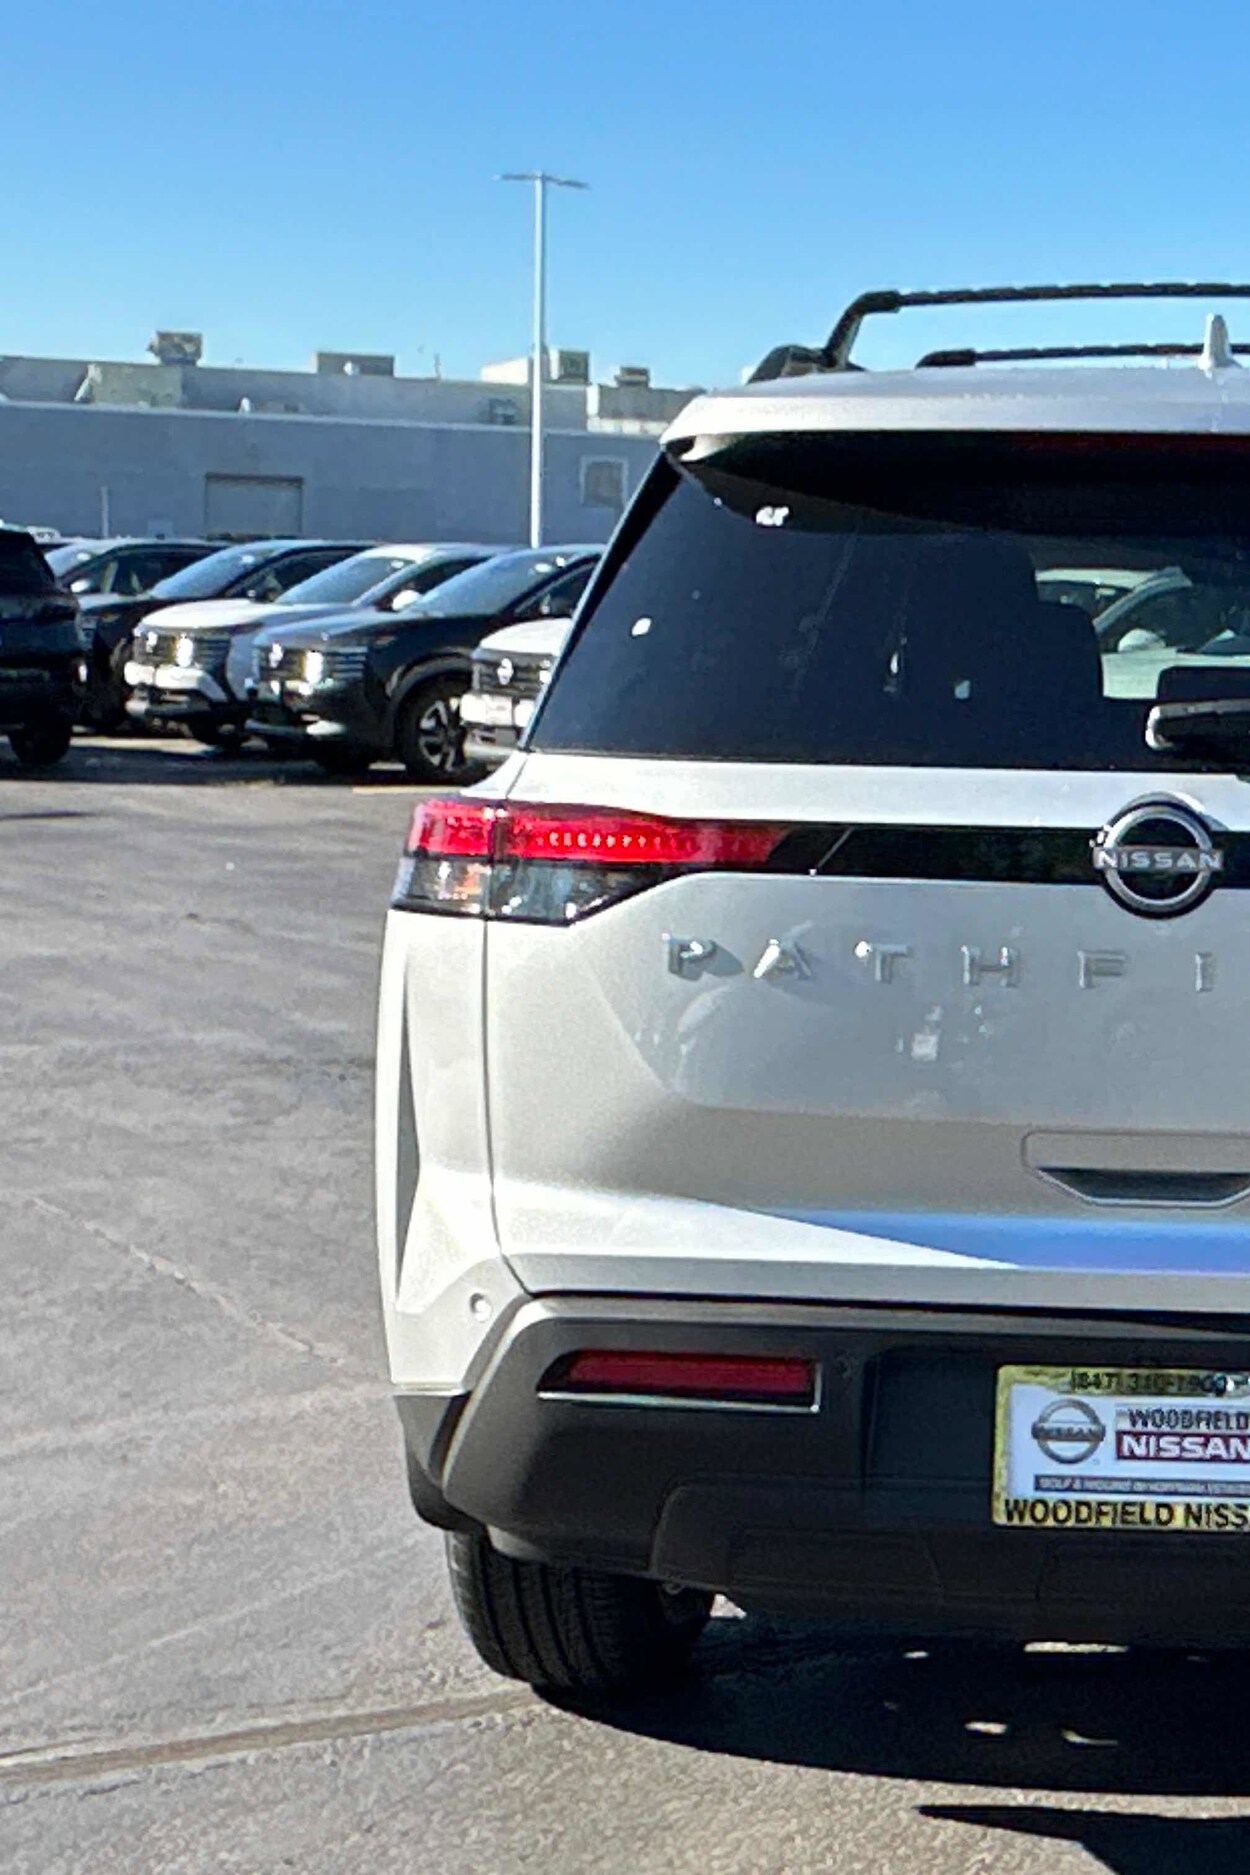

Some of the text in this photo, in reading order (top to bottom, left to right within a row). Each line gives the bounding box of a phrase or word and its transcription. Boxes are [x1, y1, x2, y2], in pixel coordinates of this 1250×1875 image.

[1098, 850, 1221, 869] NISSAN
[1128, 1407, 1250, 1430] WOODFIELD
[1004, 1499, 1175, 1528] WOODFIELD
